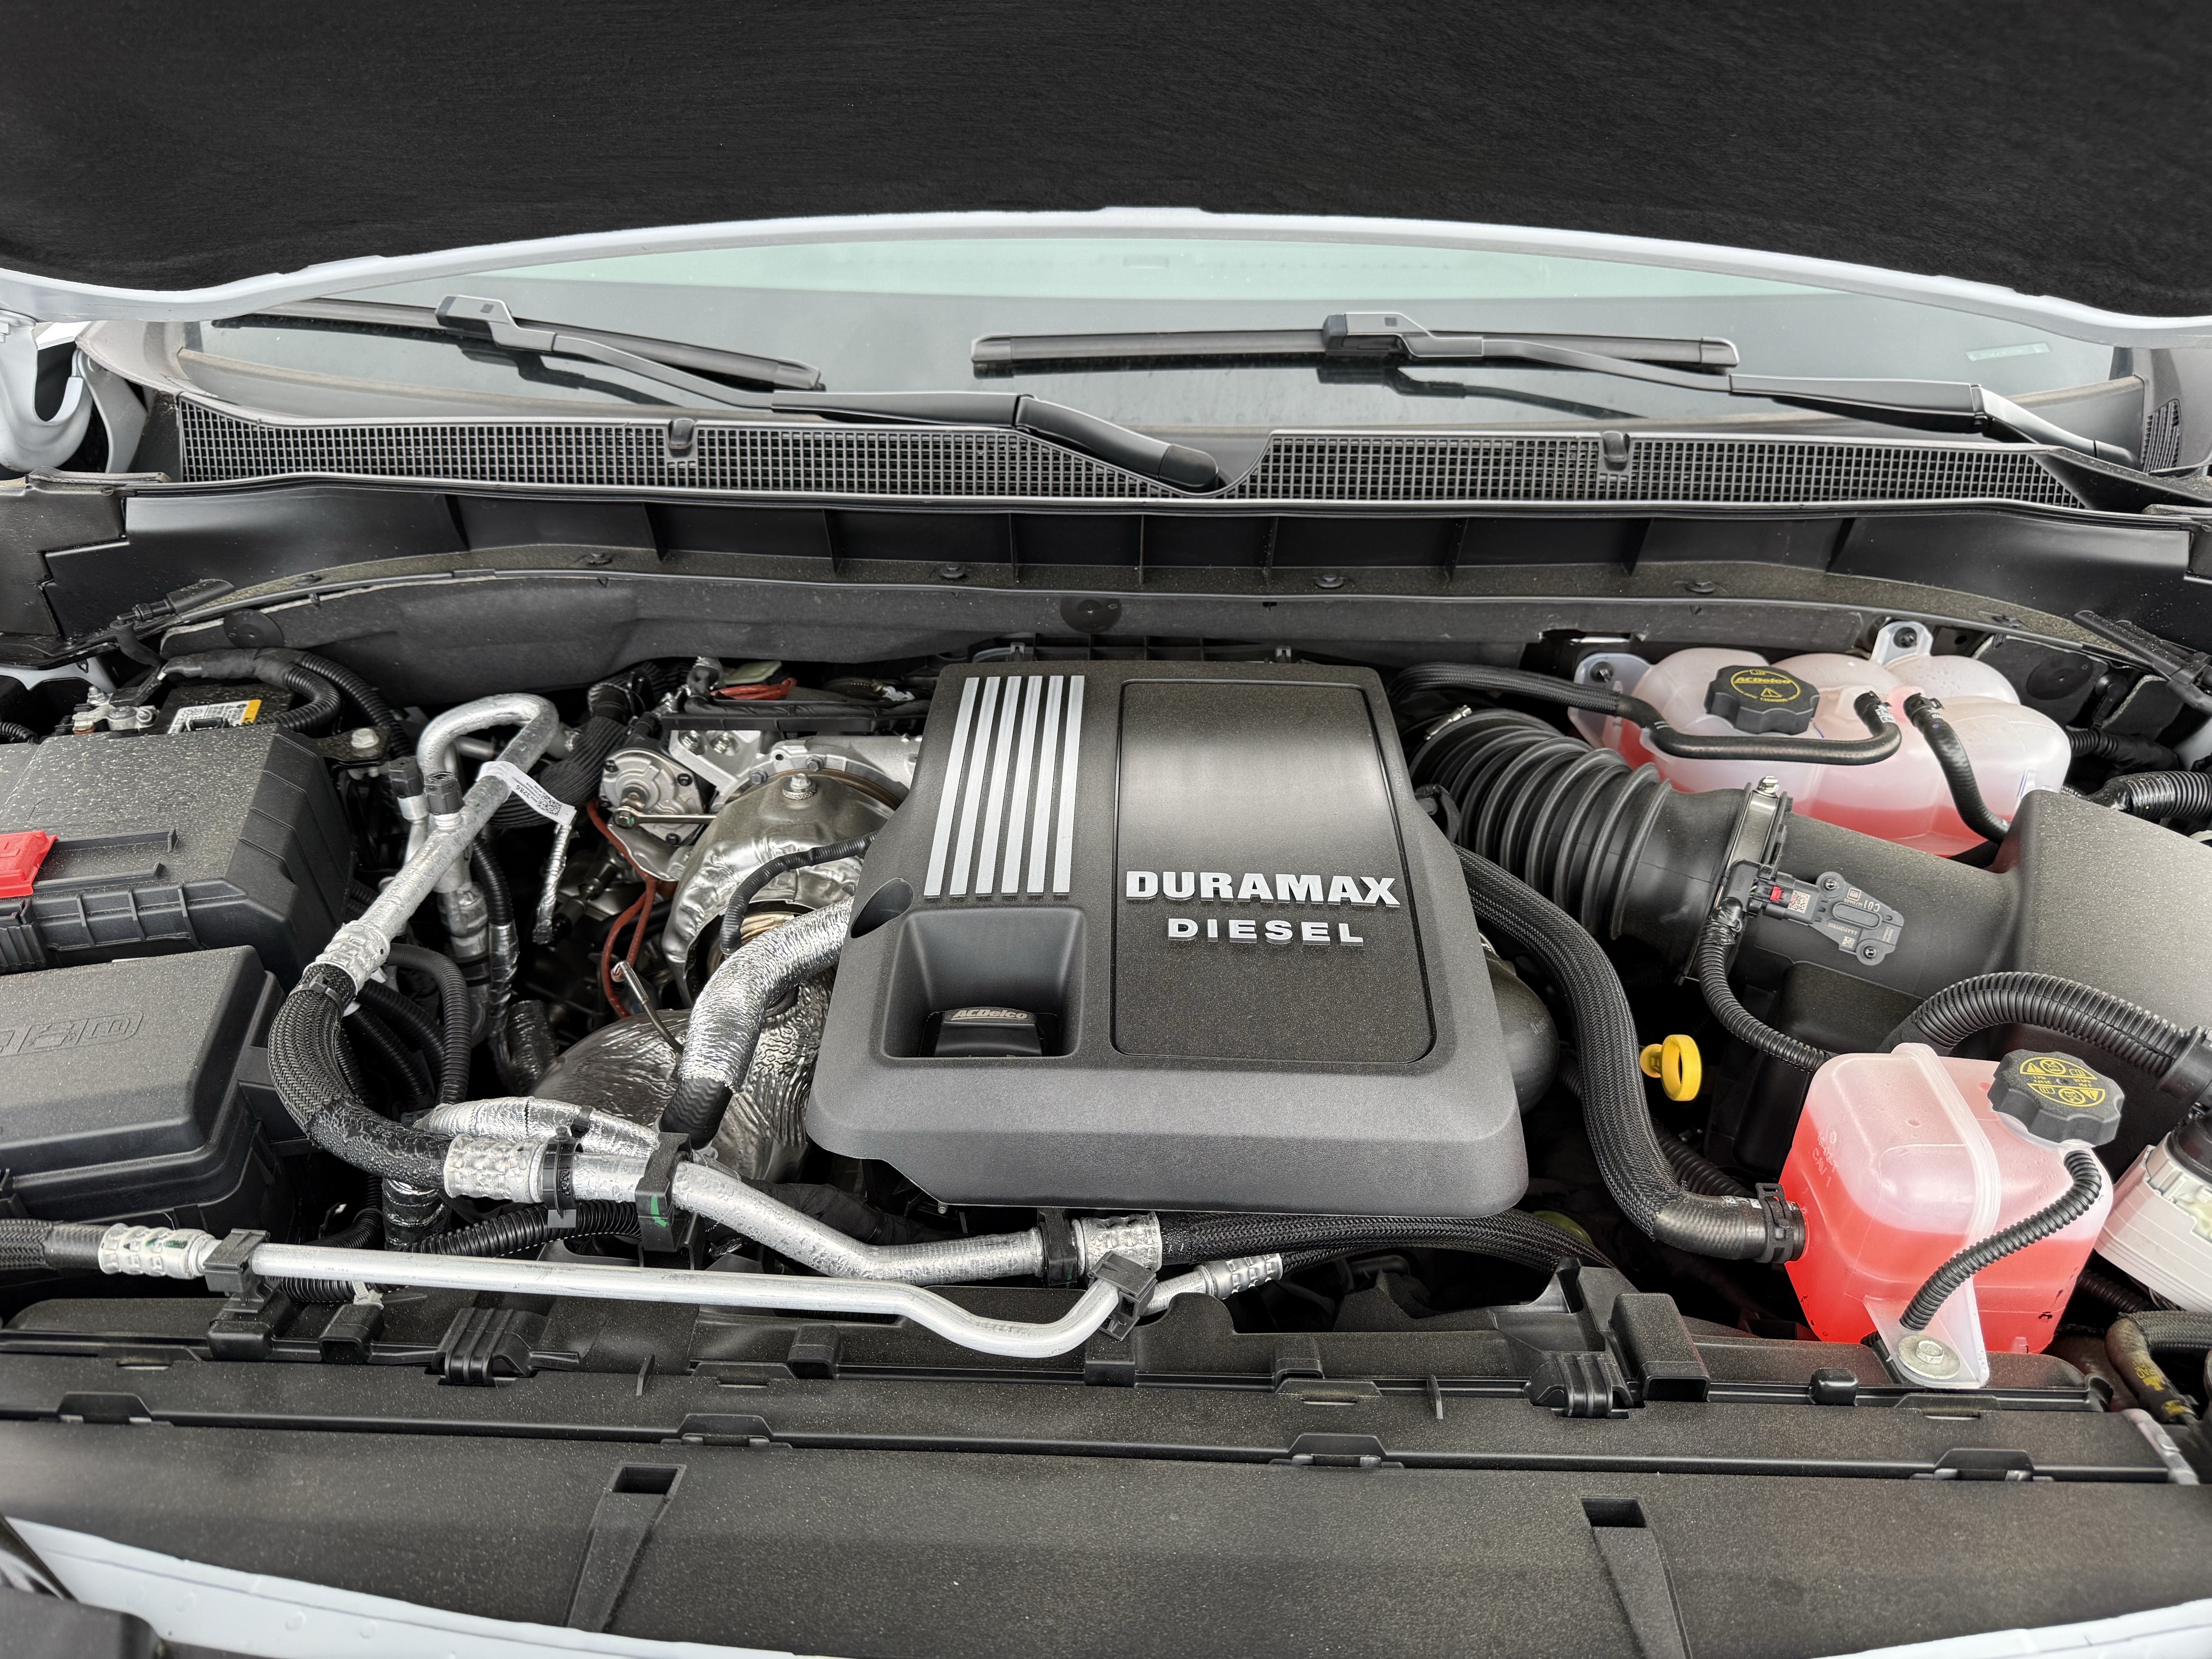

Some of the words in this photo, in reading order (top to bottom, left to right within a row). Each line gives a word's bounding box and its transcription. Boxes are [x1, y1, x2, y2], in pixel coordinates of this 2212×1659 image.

[1126, 871, 1401, 908] DURAMAX
[1864, 900, 1880, 912] C01
[1168, 918, 1364, 946] DIESEL
[951, 1009, 1028, 1020] ACDelco
